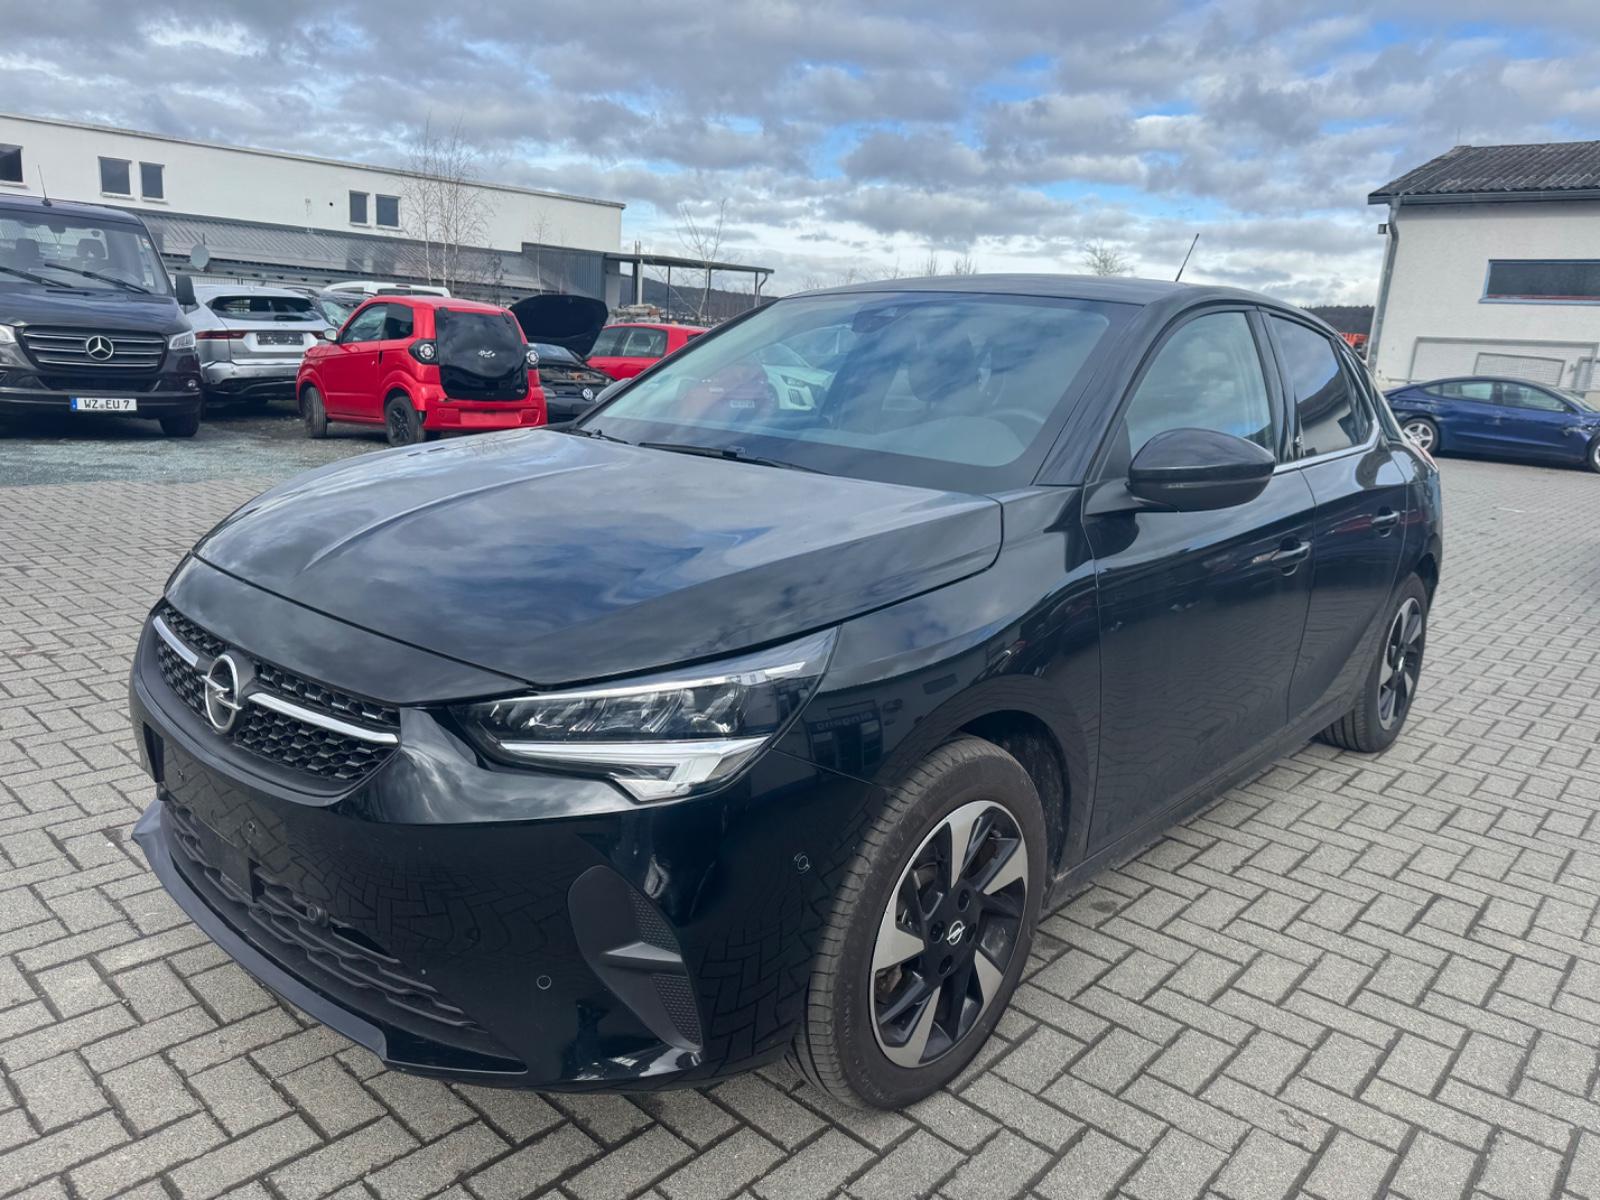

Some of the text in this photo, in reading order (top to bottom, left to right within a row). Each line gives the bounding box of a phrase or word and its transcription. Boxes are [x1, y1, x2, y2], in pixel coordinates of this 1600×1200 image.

[83, 399, 130, 410] WZ EU 7
